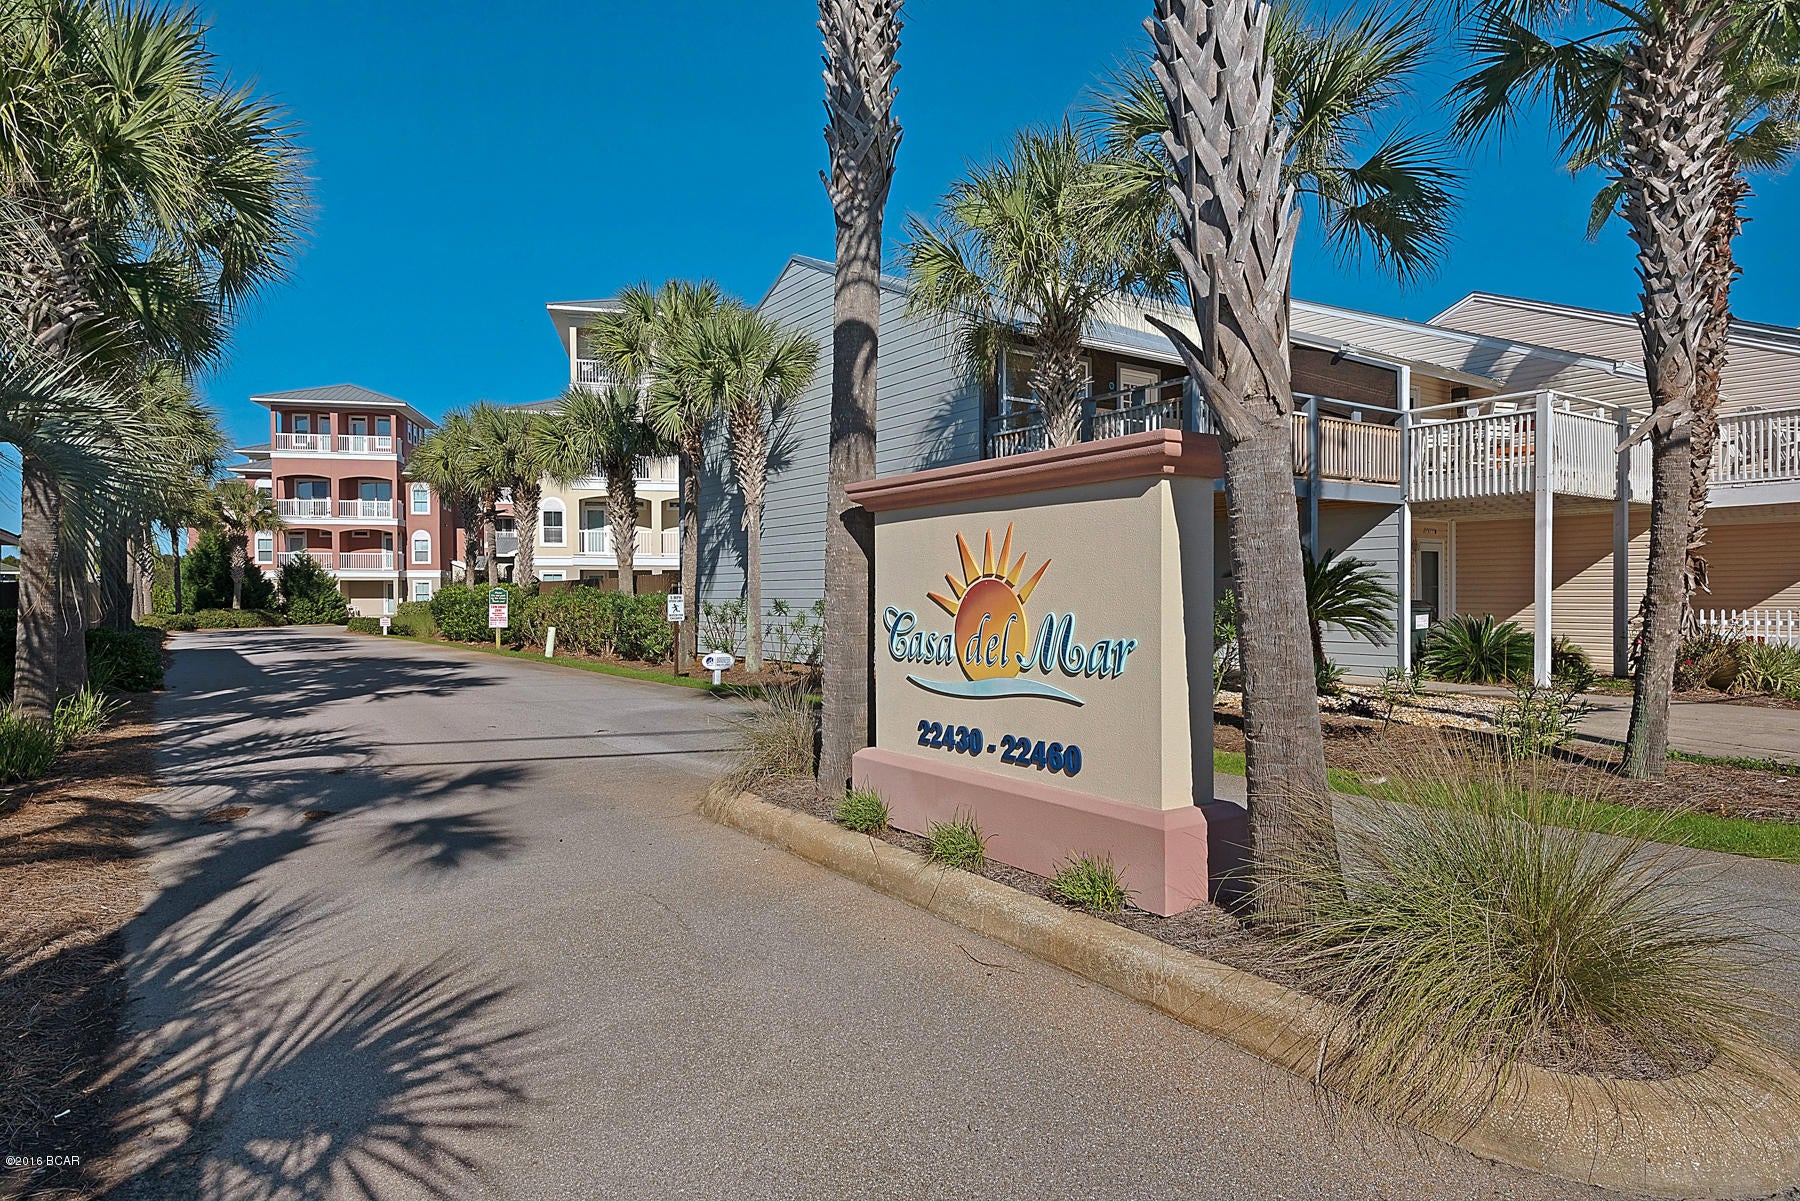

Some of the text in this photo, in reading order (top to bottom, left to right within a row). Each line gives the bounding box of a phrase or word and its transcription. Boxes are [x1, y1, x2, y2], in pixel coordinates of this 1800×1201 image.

[883, 605, 1139, 680] Casa del Mar
[917, 719, 984, 757] 22430
[1000, 734, 1083, 777] 22460
